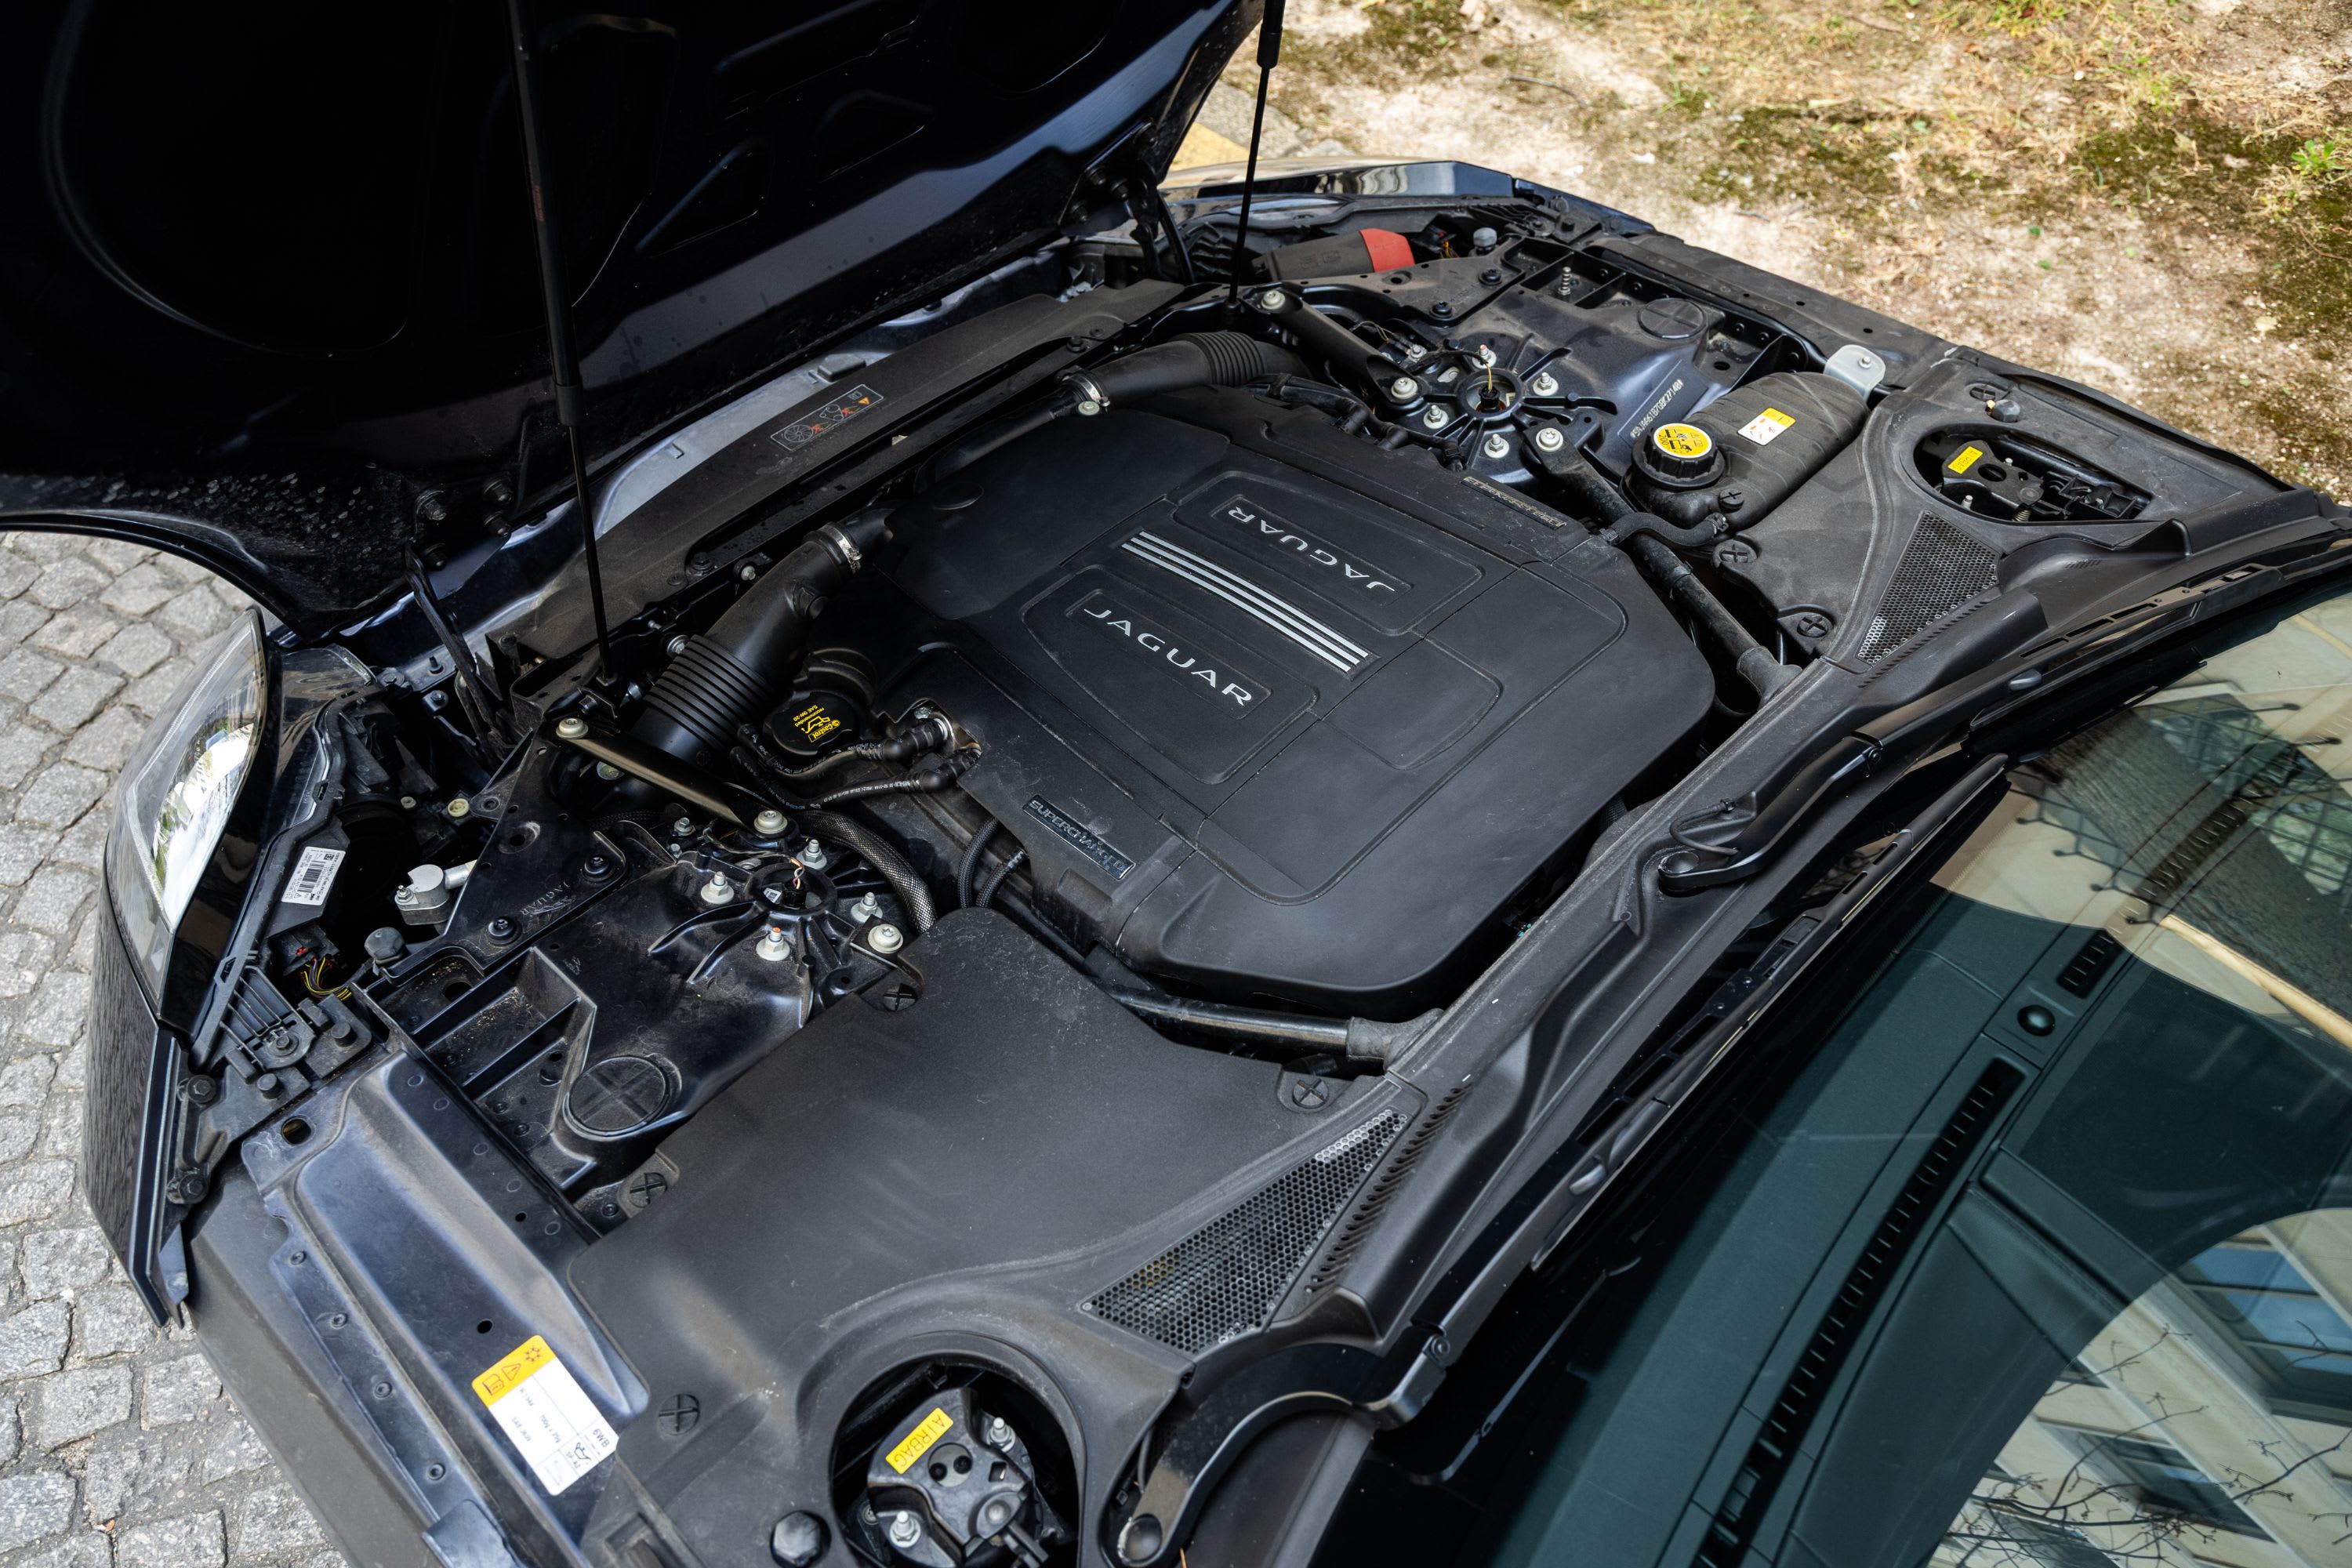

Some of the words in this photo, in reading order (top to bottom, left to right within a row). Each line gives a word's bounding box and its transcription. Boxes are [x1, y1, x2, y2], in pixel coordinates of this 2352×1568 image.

[1228, 506, 1396, 593] JAGUAR
[1083, 608, 1253, 706] JAGUAR
[793, 711, 808, 721] 0W-20
[794, 707, 825, 728] recommended
[807, 705, 818, 713] SAE
[812, 724, 833, 739] Castrol
[592, 1428, 611, 1448] 6WB
[894, 1414, 946, 1467] AIRBAG
